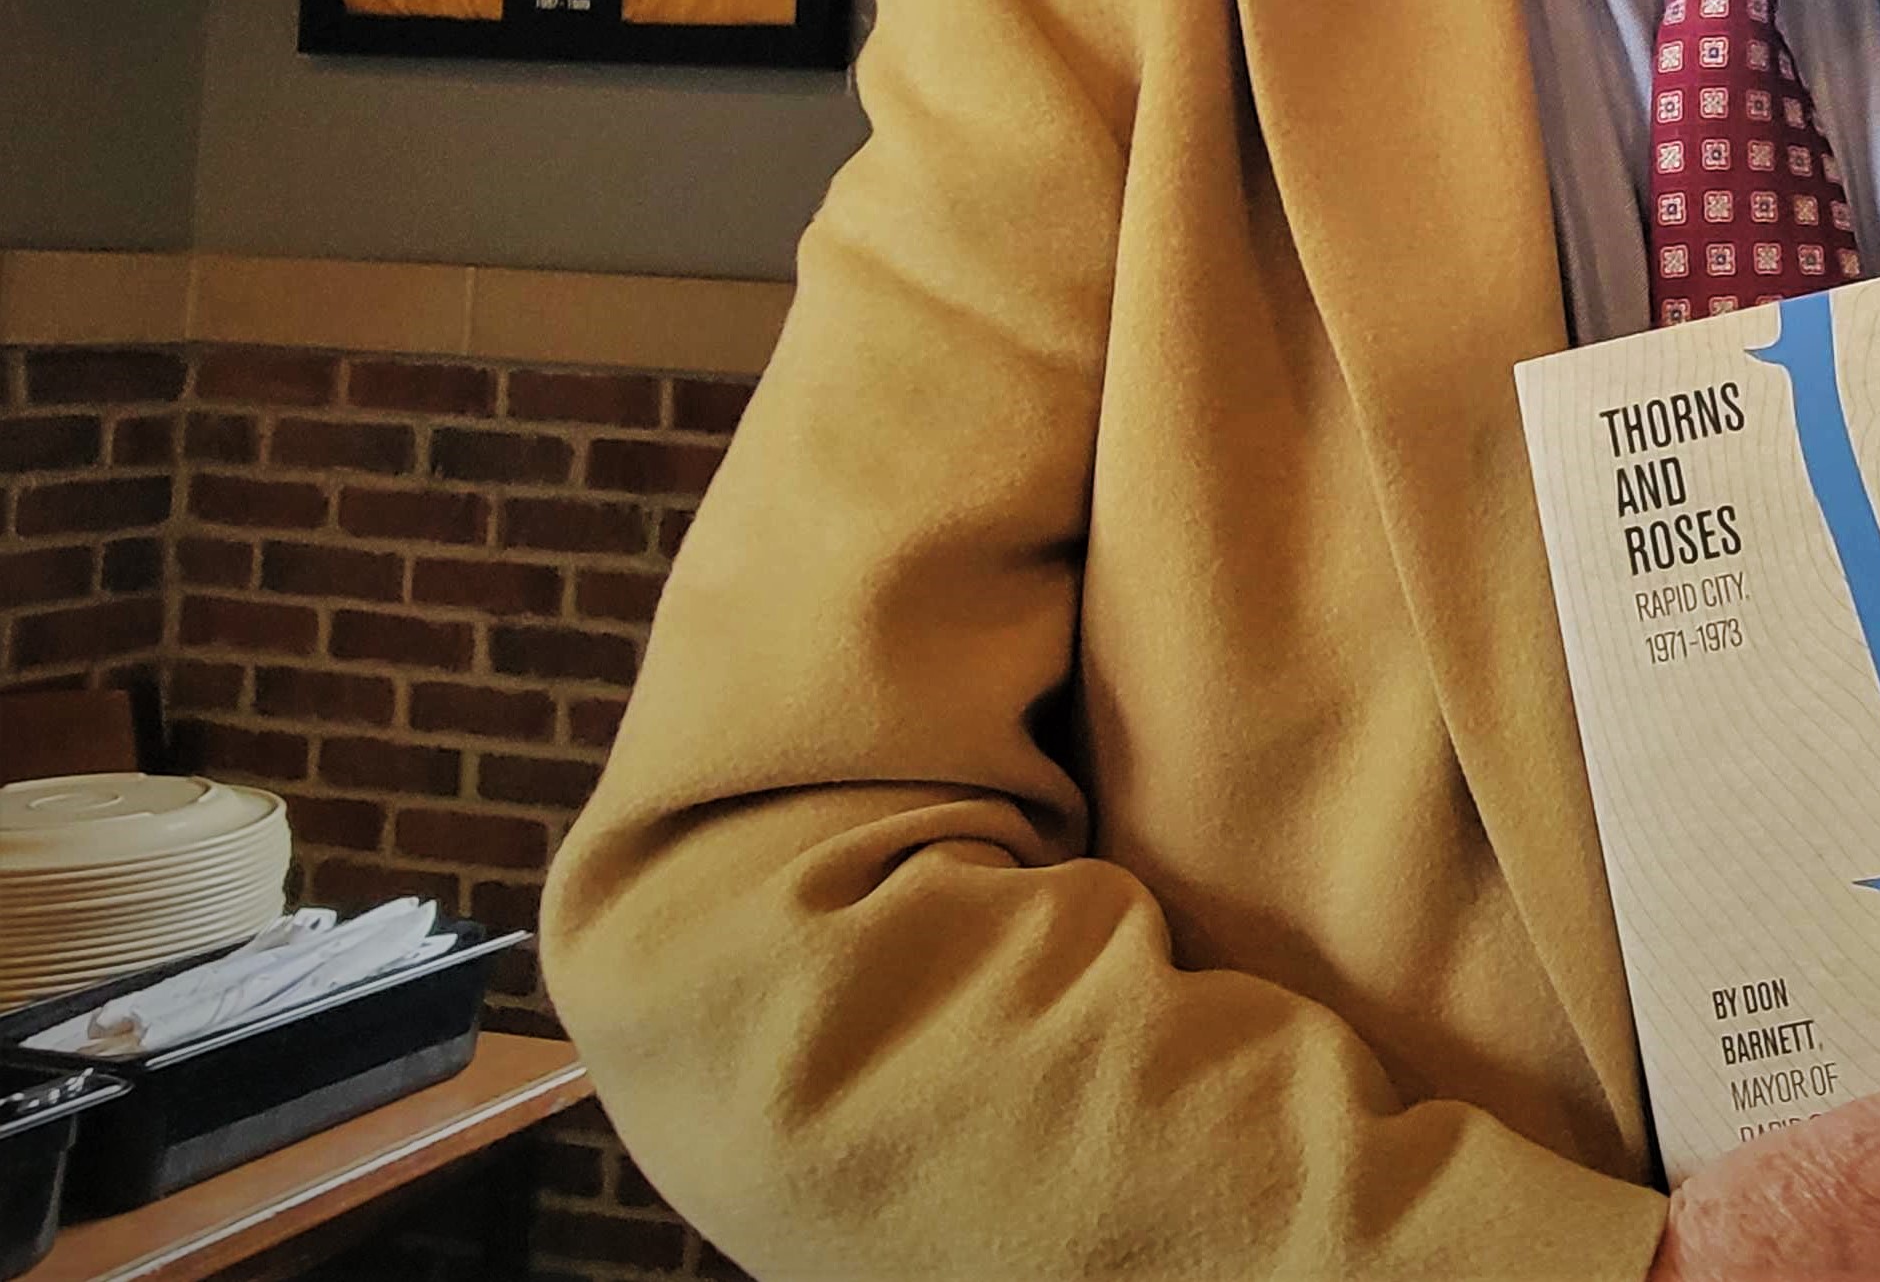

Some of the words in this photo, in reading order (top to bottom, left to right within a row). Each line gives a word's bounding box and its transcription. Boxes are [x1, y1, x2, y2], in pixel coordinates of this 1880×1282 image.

[1599, 382, 1746, 458] THORNS
[1616, 456, 1687, 518] AND
[1624, 505, 1742, 577] ROSES
[1635, 582, 1698, 622] RAPID
[1645, 618, 1744, 665] 1971-1973
[1712, 987, 1737, 1020] BY
[1742, 978, 1789, 1015] DON
[1721, 1020, 1824, 1066] BARNETT,
[1730, 1068, 1809, 1112] MAYOR
[1810, 1062, 1839, 1097] OF
